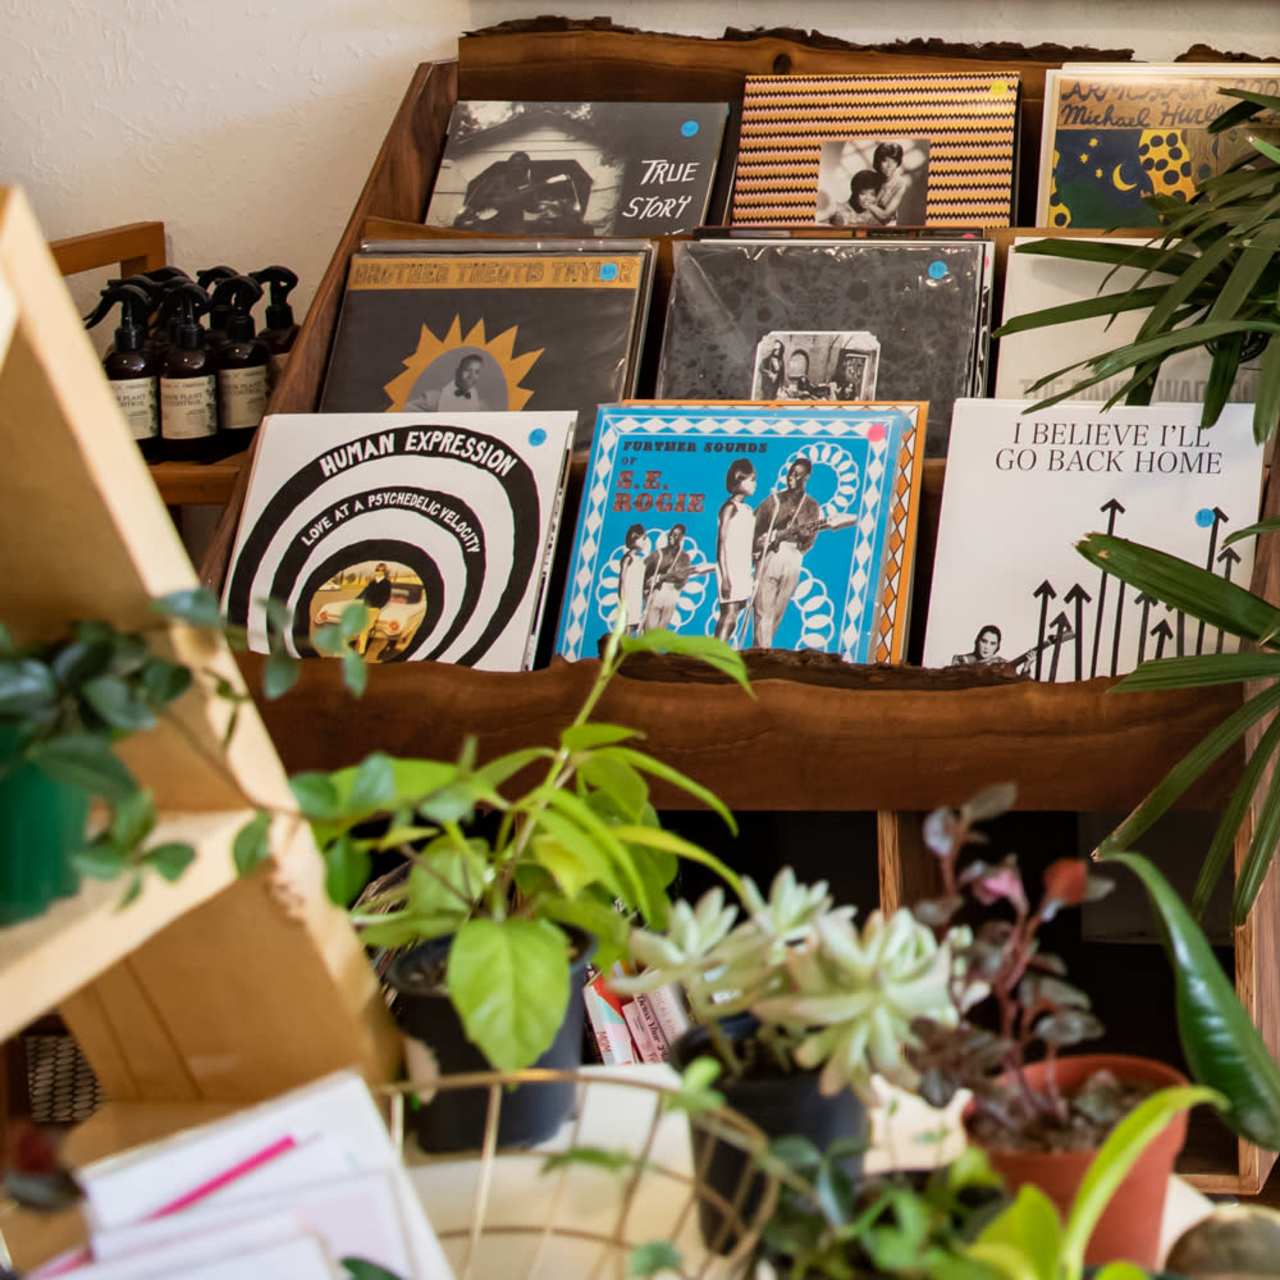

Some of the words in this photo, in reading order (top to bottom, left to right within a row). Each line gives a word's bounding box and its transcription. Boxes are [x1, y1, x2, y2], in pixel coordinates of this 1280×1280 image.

[1060, 103, 1151, 128] Michael
[1158, 101, 1230, 128] Hurle
[640, 159, 700, 185] TRUE
[622, 195, 692, 220] STORY
[622, 440, 697, 453] FURTHER
[703, 442, 769, 454] SOUNDS
[1013, 422, 1021, 444] I
[1032, 422, 1150, 447] BELIEVE
[319, 432, 396, 477] HUMAN
[404, 430, 517, 478] EXPRESSION
[621, 457, 638, 466] OF
[995, 448, 1038, 471] GO
[1048, 449, 1124, 474] BACK
[1134, 451, 1223, 475] HOME
[616, 470, 670, 491] S.E.
[611, 492, 705, 513] ROGIE
[301, 518, 333, 546] LOVE
[334, 502, 350, 521] AT
[354, 499, 365, 513] A
[367, 491, 441, 516] PSYCHEDELIC
[439, 506, 481, 554] VELOCITY
